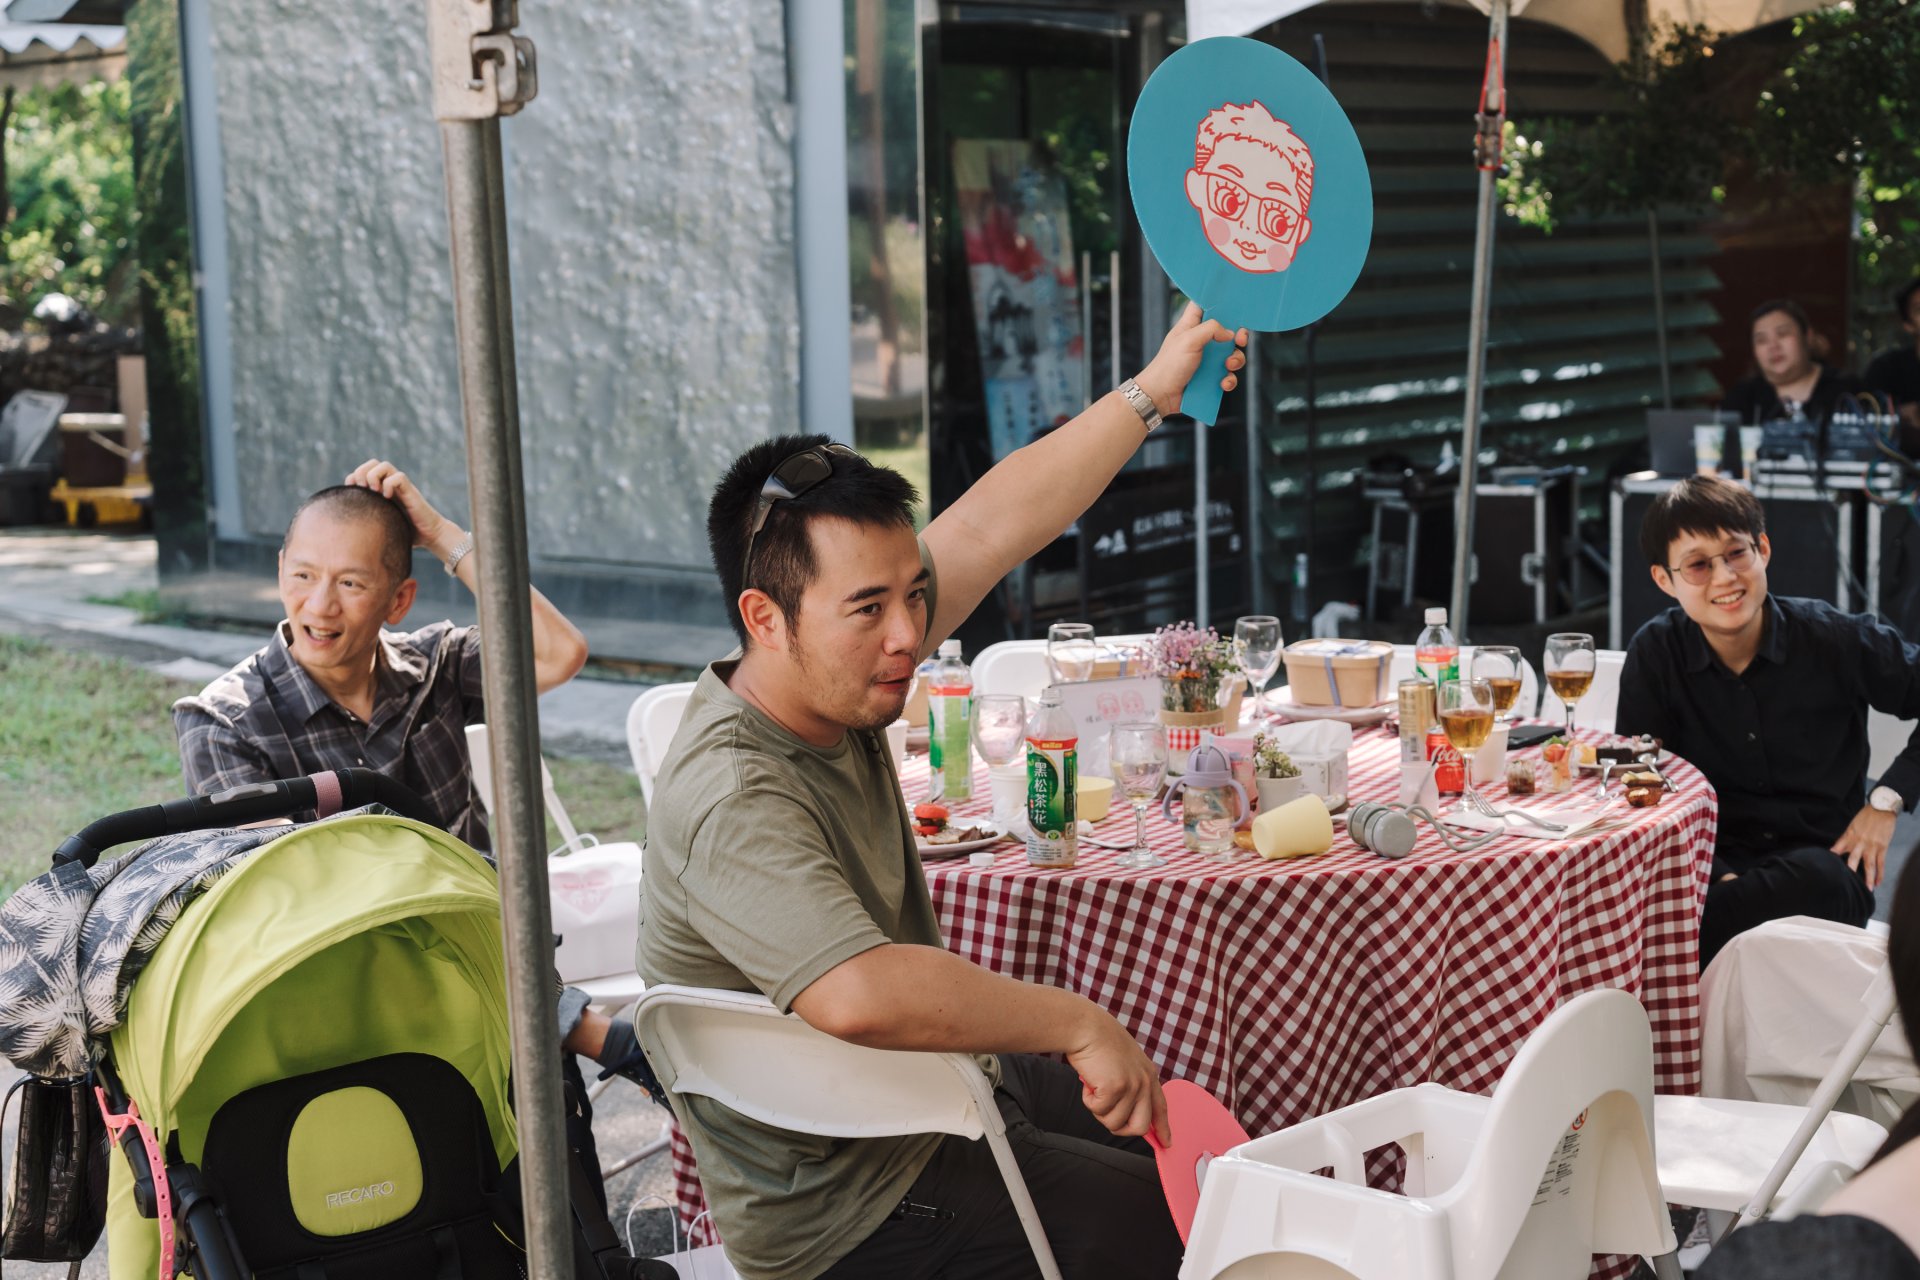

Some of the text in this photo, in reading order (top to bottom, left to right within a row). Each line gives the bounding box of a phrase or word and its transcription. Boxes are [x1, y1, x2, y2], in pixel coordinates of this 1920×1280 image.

[1034, 761, 1047, 825] 黑松茶花
[326, 1181, 395, 1209] RECARO
